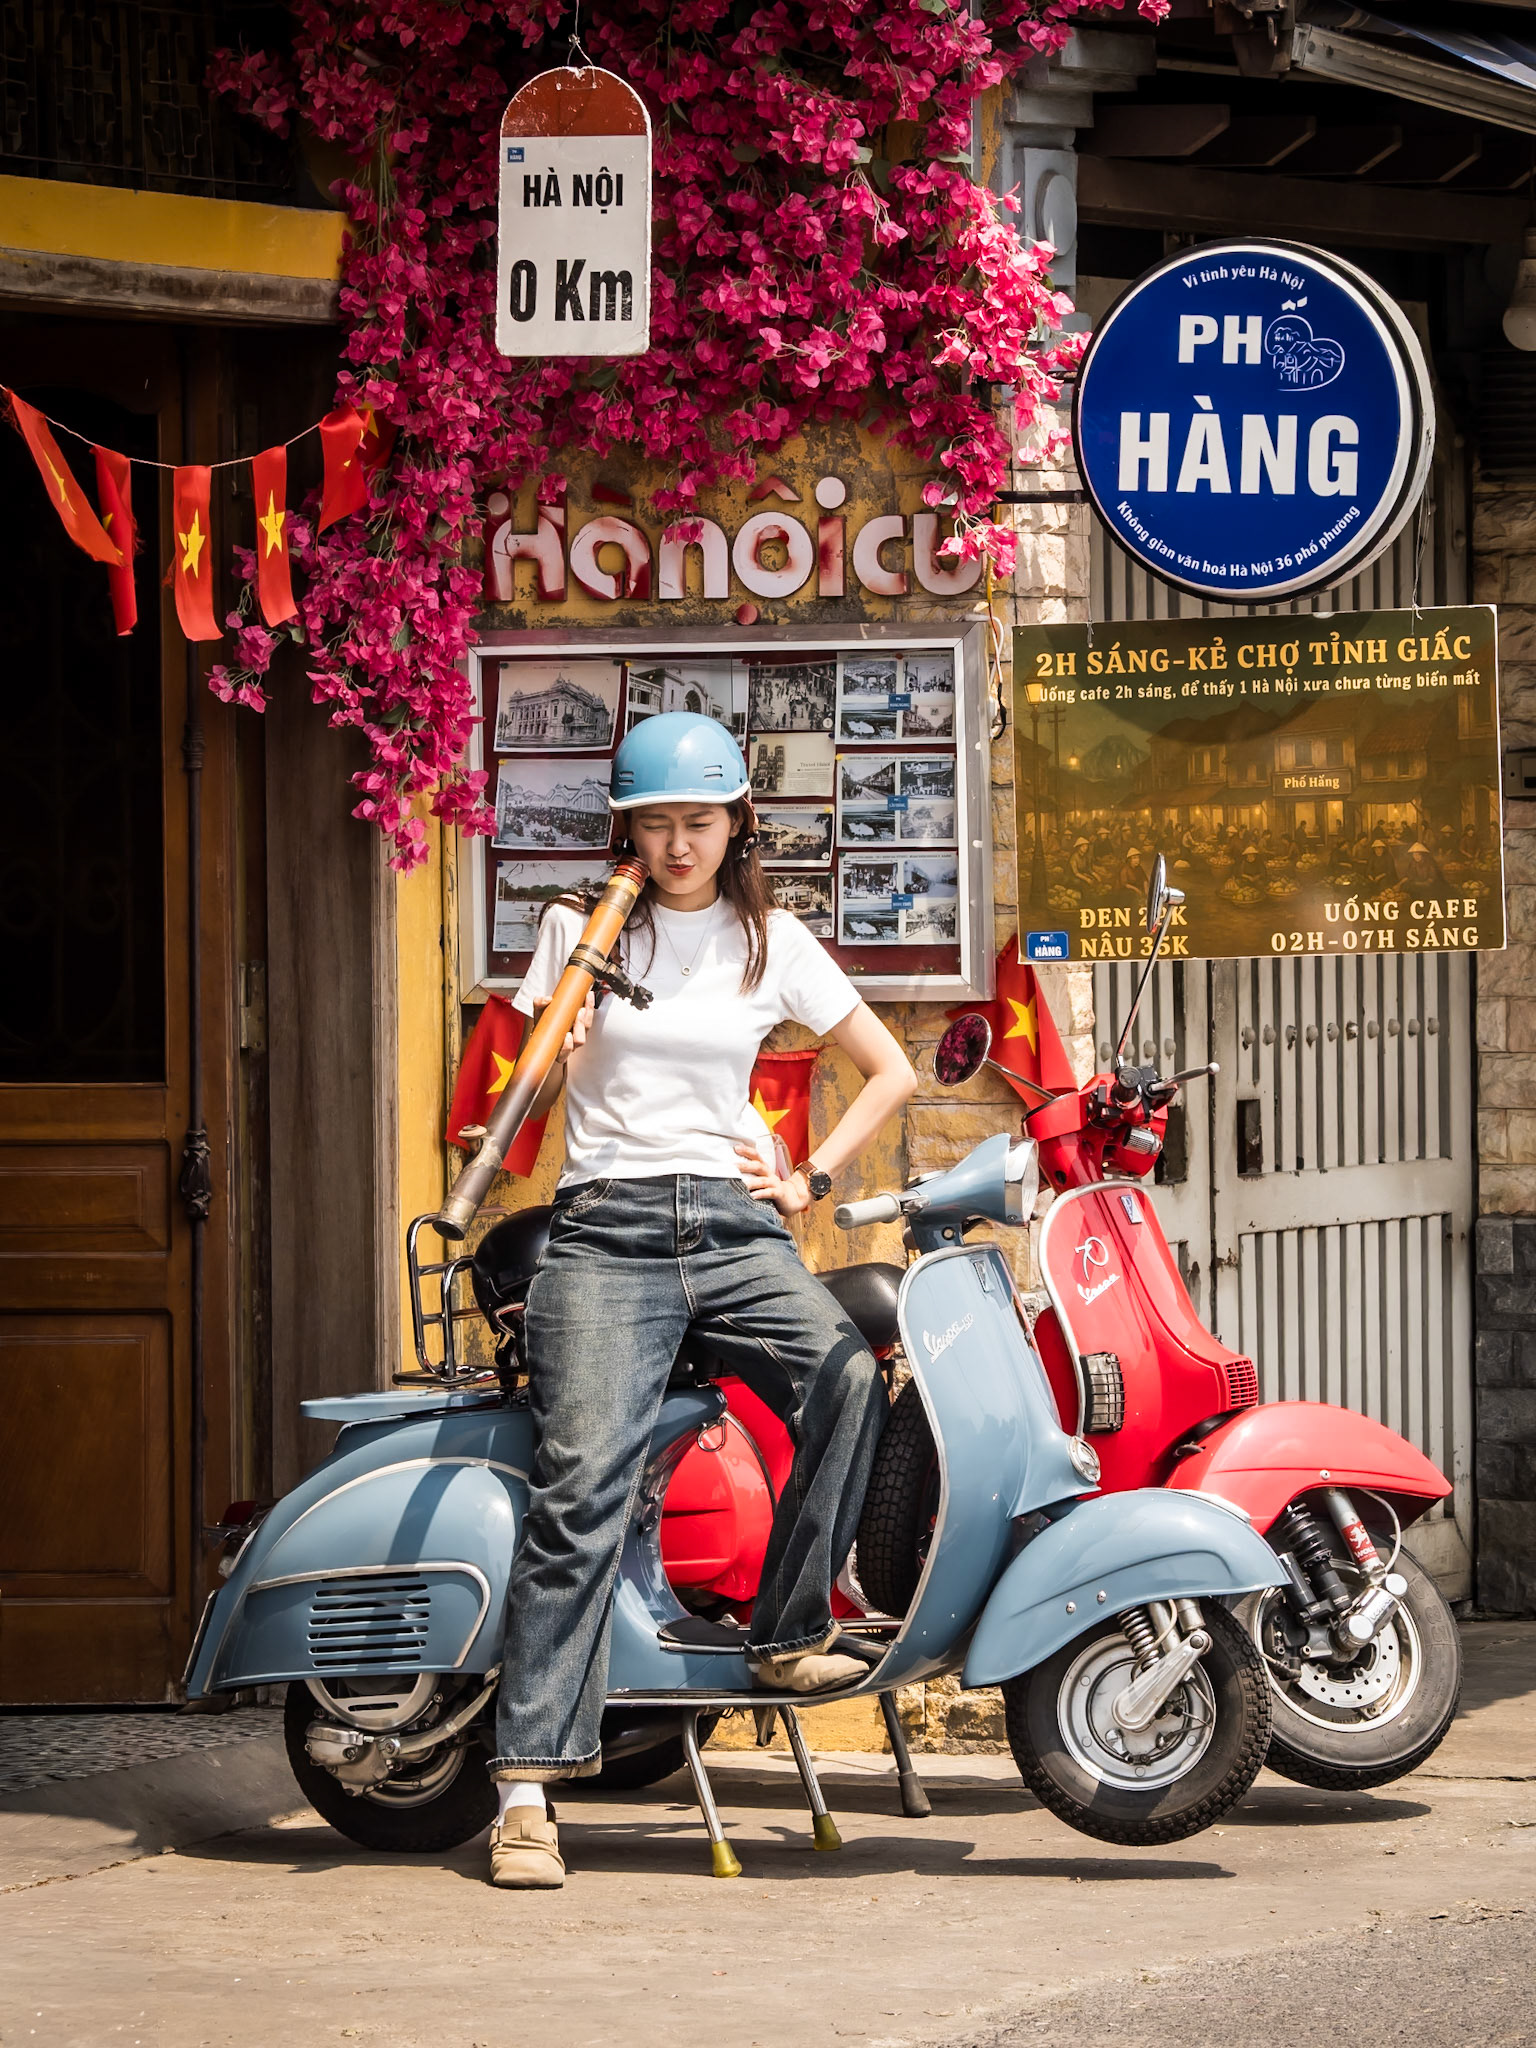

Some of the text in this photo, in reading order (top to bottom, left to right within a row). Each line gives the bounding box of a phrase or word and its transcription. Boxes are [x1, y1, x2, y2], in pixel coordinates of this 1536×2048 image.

[523, 166, 623, 214] HÀ NỘI
[509, 259, 633, 323] 0 Km
[1200, 266, 1228, 283] tình
[1231, 265, 1255, 280] yêu
[1259, 266, 1277, 281] Hà
[1280, 271, 1305, 290] Nội
[1118, 395, 1360, 497] HÀNG
[1117, 501, 1361, 577] Không gian văn hoá Hà Nội 36 phố phường
[1036, 652, 1077, 677] 2H
[1237, 640, 1300, 675] CHỢ
[1309, 631, 1388, 666] TỈNH
[1397, 626, 1472, 663] GIẤC
[1080, 686, 1110, 701] cafe
[1115, 684, 1133, 699] 2h
[1138, 683, 1177, 700] sáng,
[1181, 679, 1200, 697] để
[1203, 680, 1235, 698] thấy
[1240, 680, 1247, 694] 1
[1252, 677, 1270, 694] Hà
[1275, 677, 1298, 696] Nội
[1303, 679, 1330, 692] xưa
[1335, 676, 1371, 691] chưa
[1375, 673, 1412, 691] từng
[1416, 671, 1448, 687] biến
[1453, 668, 1480, 686] mất
[1283, 774, 1307, 789] Phố
[1080, 907, 1131, 928] ĐEN
[1324, 894, 1478, 922] UỐNG CAFE
[1080, 931, 1133, 958] NÂU
[1271, 921, 1479, 952] 02H-07H SÁNG
